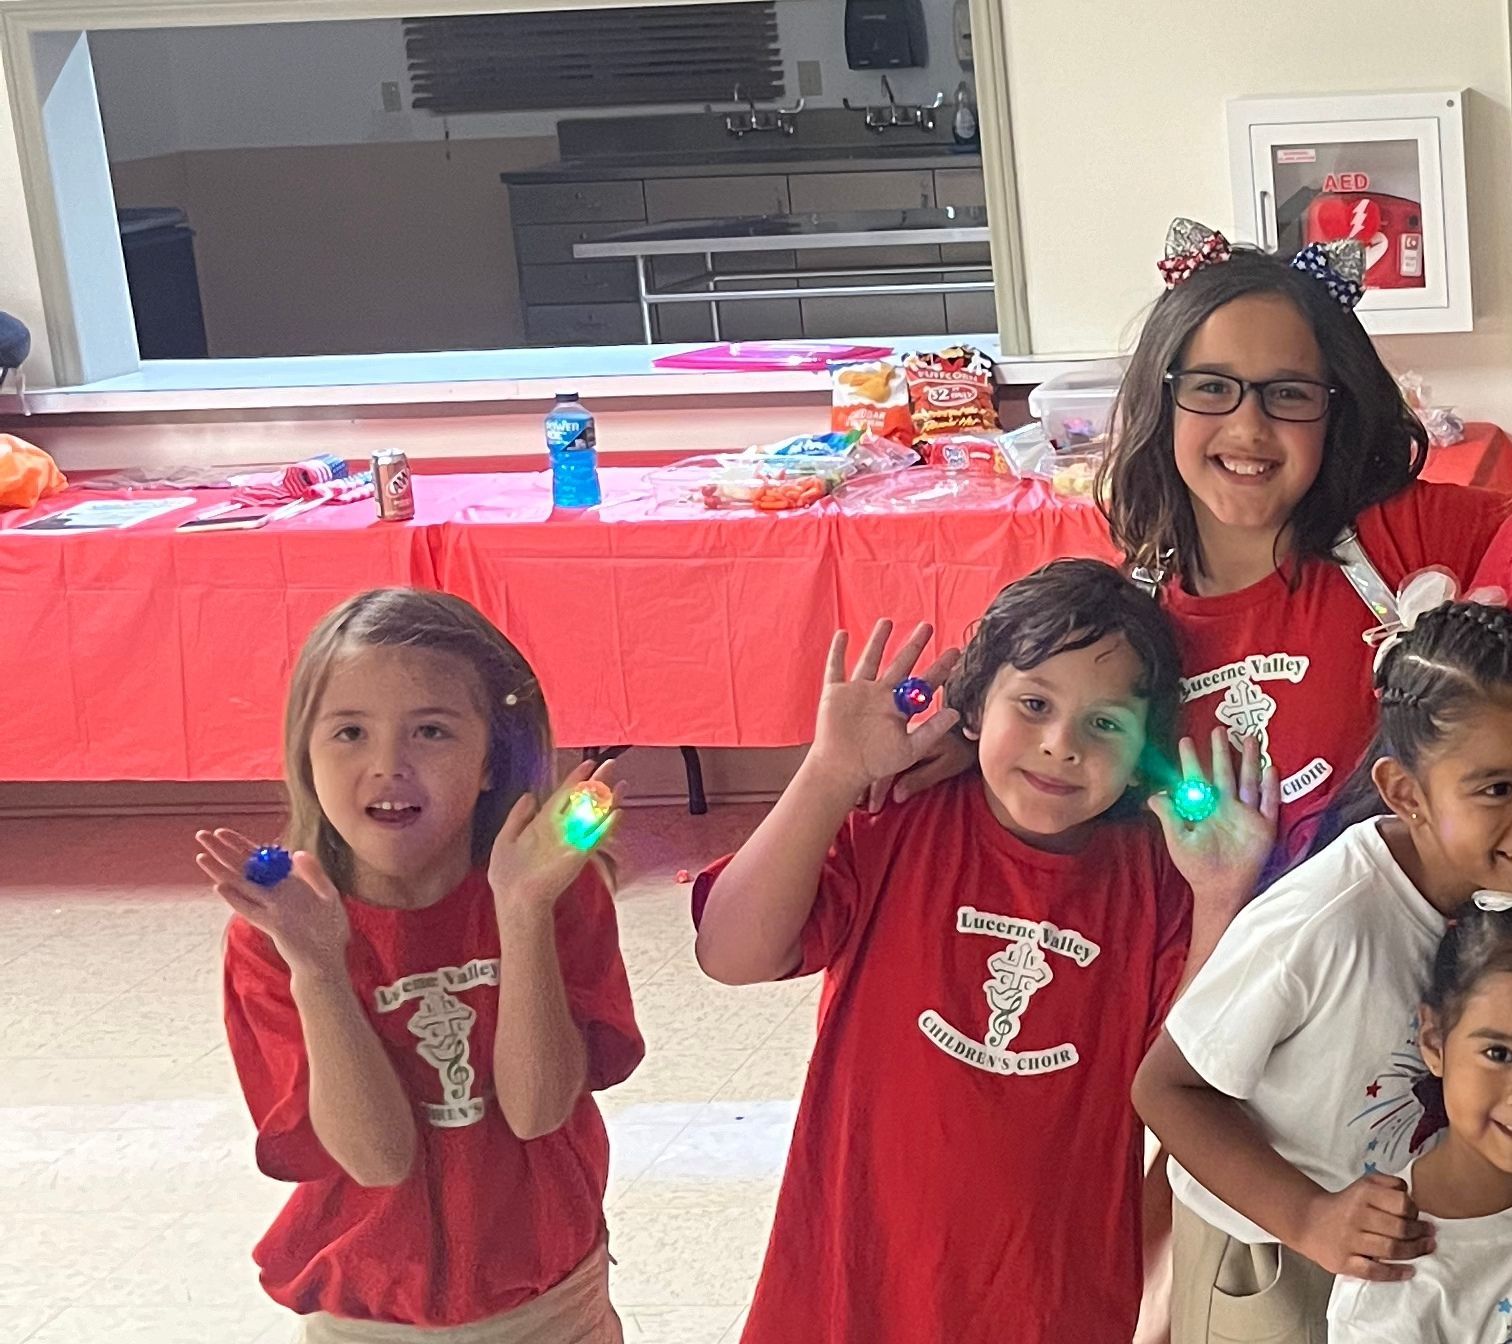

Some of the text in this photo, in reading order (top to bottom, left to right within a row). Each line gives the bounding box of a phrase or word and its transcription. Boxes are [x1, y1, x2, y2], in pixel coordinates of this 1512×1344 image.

[1324, 173, 1369, 191] AED
[1251, 657, 1304, 676] Valley
[1282, 761, 1327, 796] CHOIR
[961, 912, 1095, 963] Lucerne Valley
[922, 1015, 1072, 1071] CHILDREN'S CHOIR
